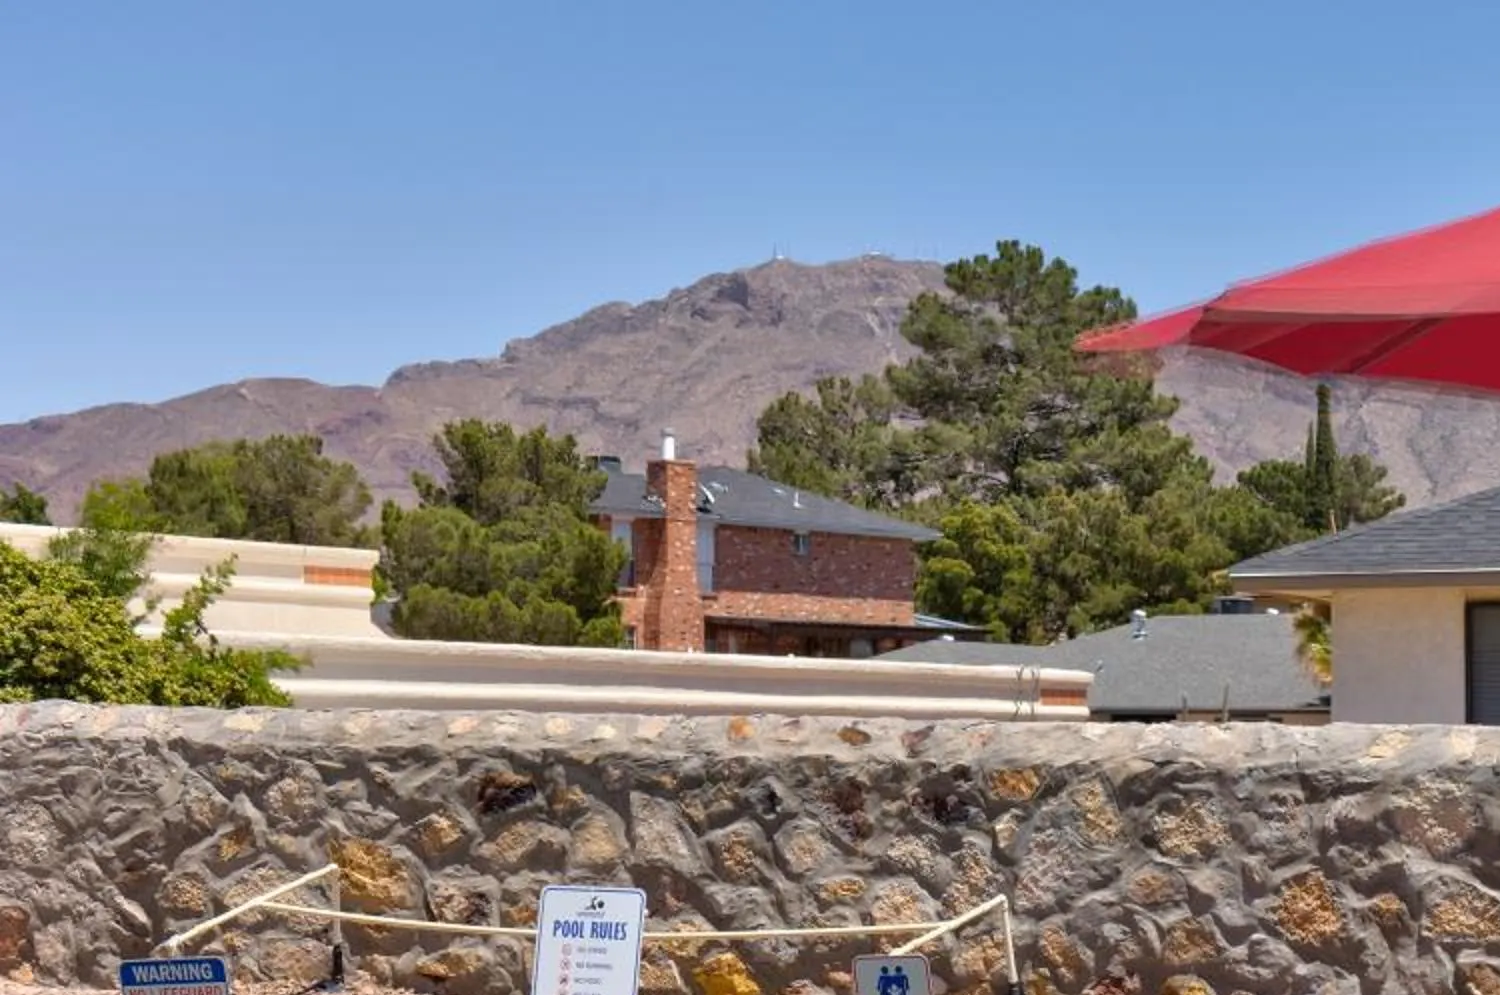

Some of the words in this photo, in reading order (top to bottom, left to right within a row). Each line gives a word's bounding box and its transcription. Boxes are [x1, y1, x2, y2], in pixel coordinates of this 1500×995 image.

[553, 920, 585, 938] POOL
[589, 921, 628, 940] RULES
[131, 963, 213, 983] WARNING
